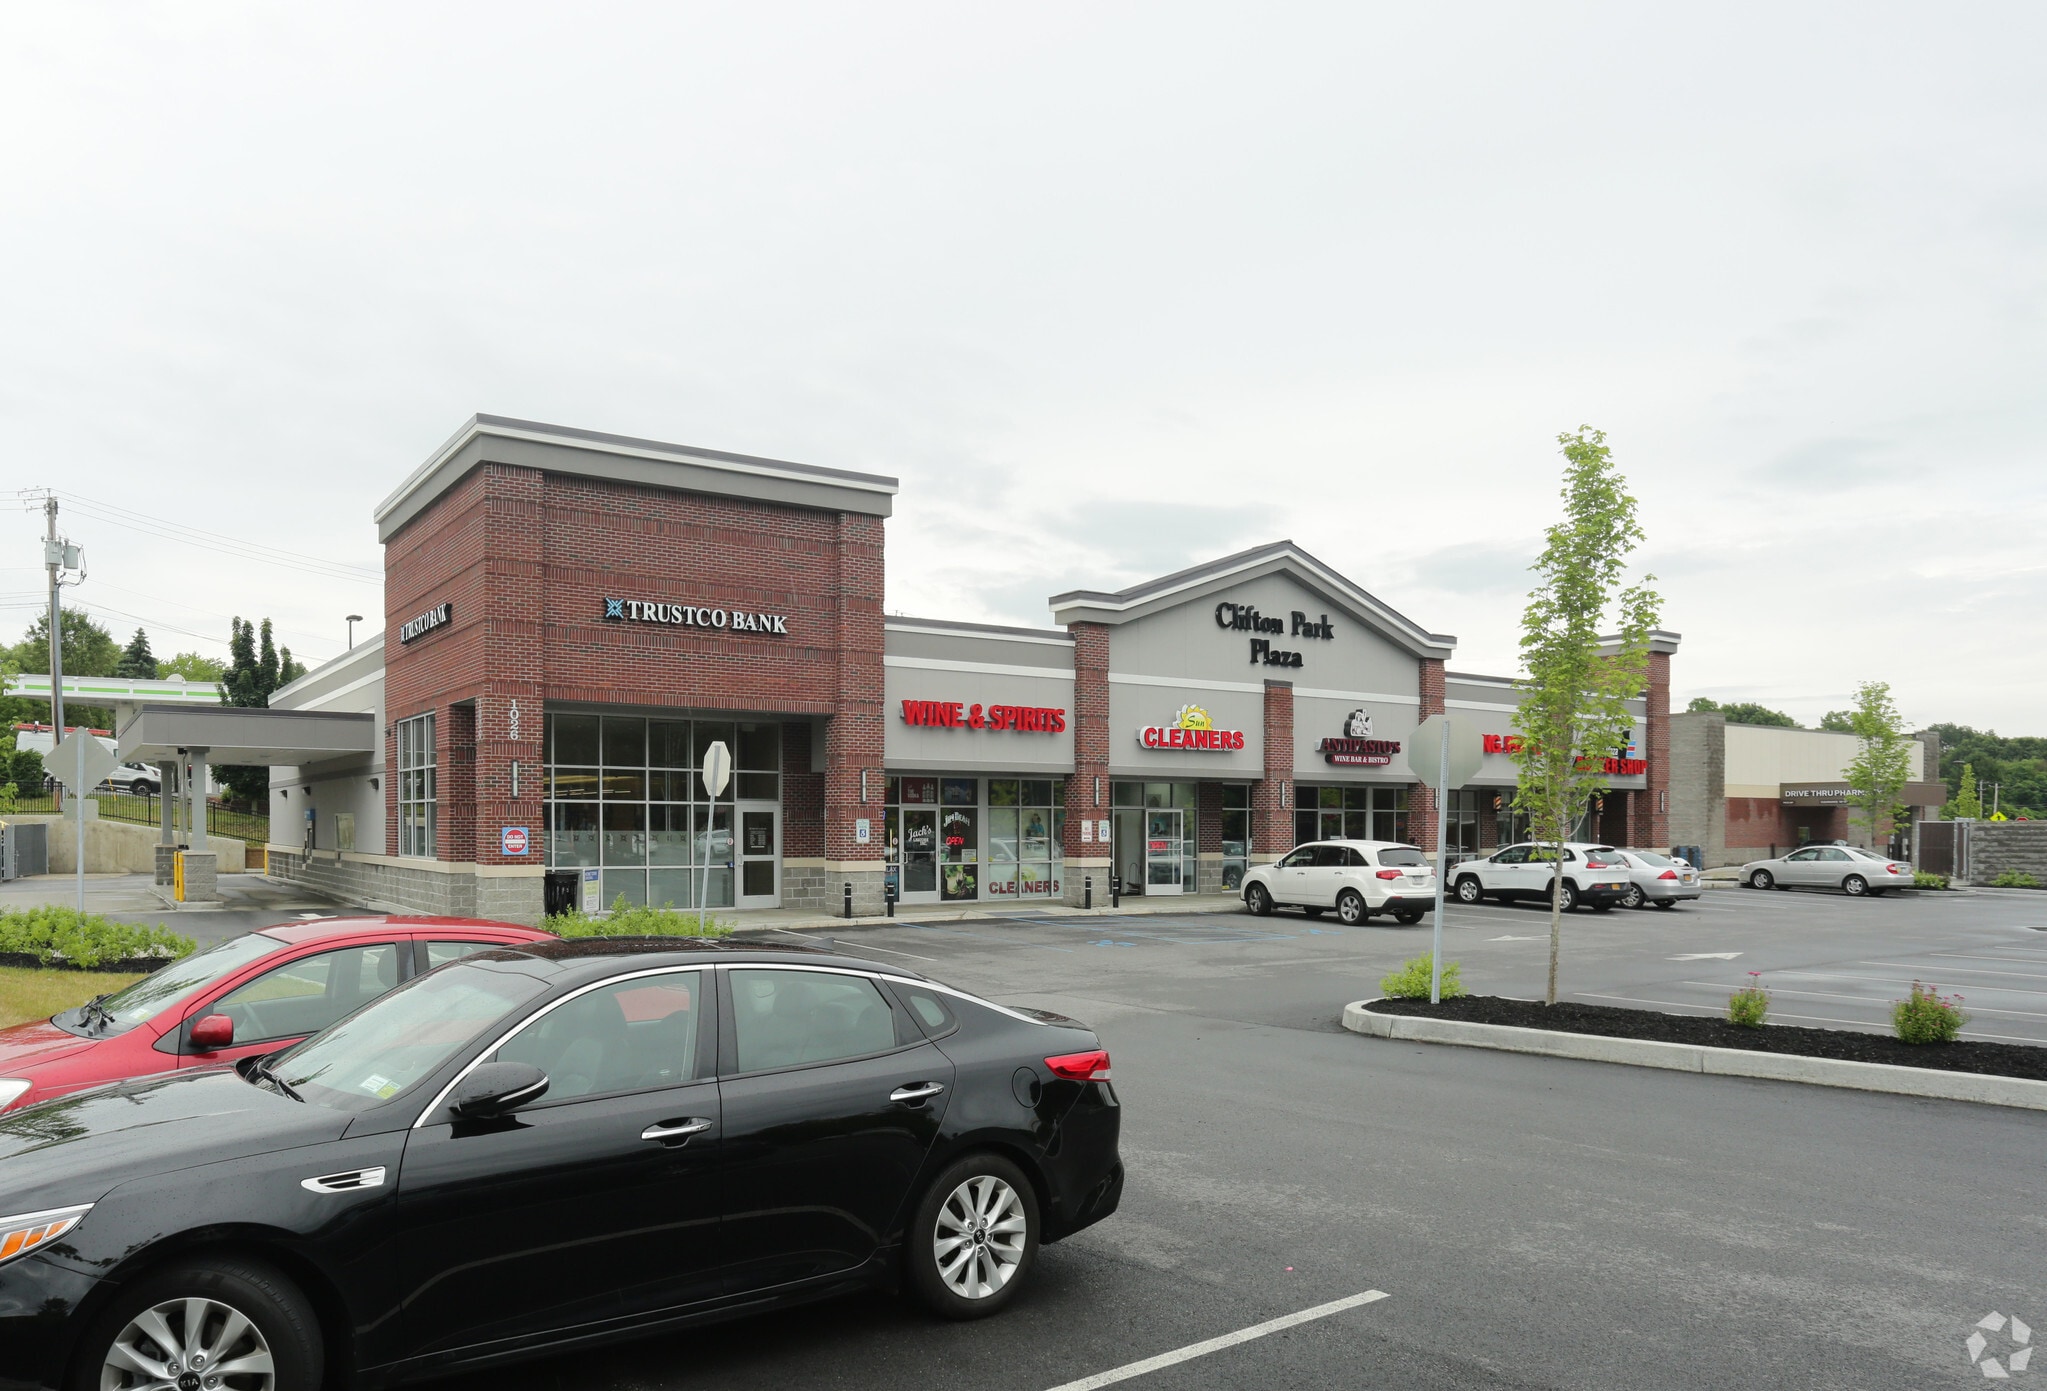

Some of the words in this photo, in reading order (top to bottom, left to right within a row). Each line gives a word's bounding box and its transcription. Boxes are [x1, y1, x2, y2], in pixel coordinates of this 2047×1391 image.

[627, 600, 727, 627] TRUSTCO
[732, 611, 788, 634] BANK
[1215, 602, 1284, 634] Clifton
[1291, 611, 1334, 639] Park
[1250, 638, 1304, 667] Plaza
[510, 699, 519, 740] 1026
[901, 700, 964, 728] WINE
[968, 704, 985, 729] &
[988, 705, 1066, 733] SPIRITS
[1186, 715, 1205, 728] Sun
[1144, 727, 1245, 749] CLEANERS
[1322, 737, 1401, 754] ANTIPASTO'S
[1334, 755, 1350, 763] WINE
[1350, 755, 1362, 763] BAR
[1620, 758, 1648, 775] SHOP
[1785, 790, 1810, 798] DRIVE
[1811, 789, 1834, 797] THRU
[945, 836, 965, 846] OPEN
[989, 880, 1060, 895] CLEANERS
